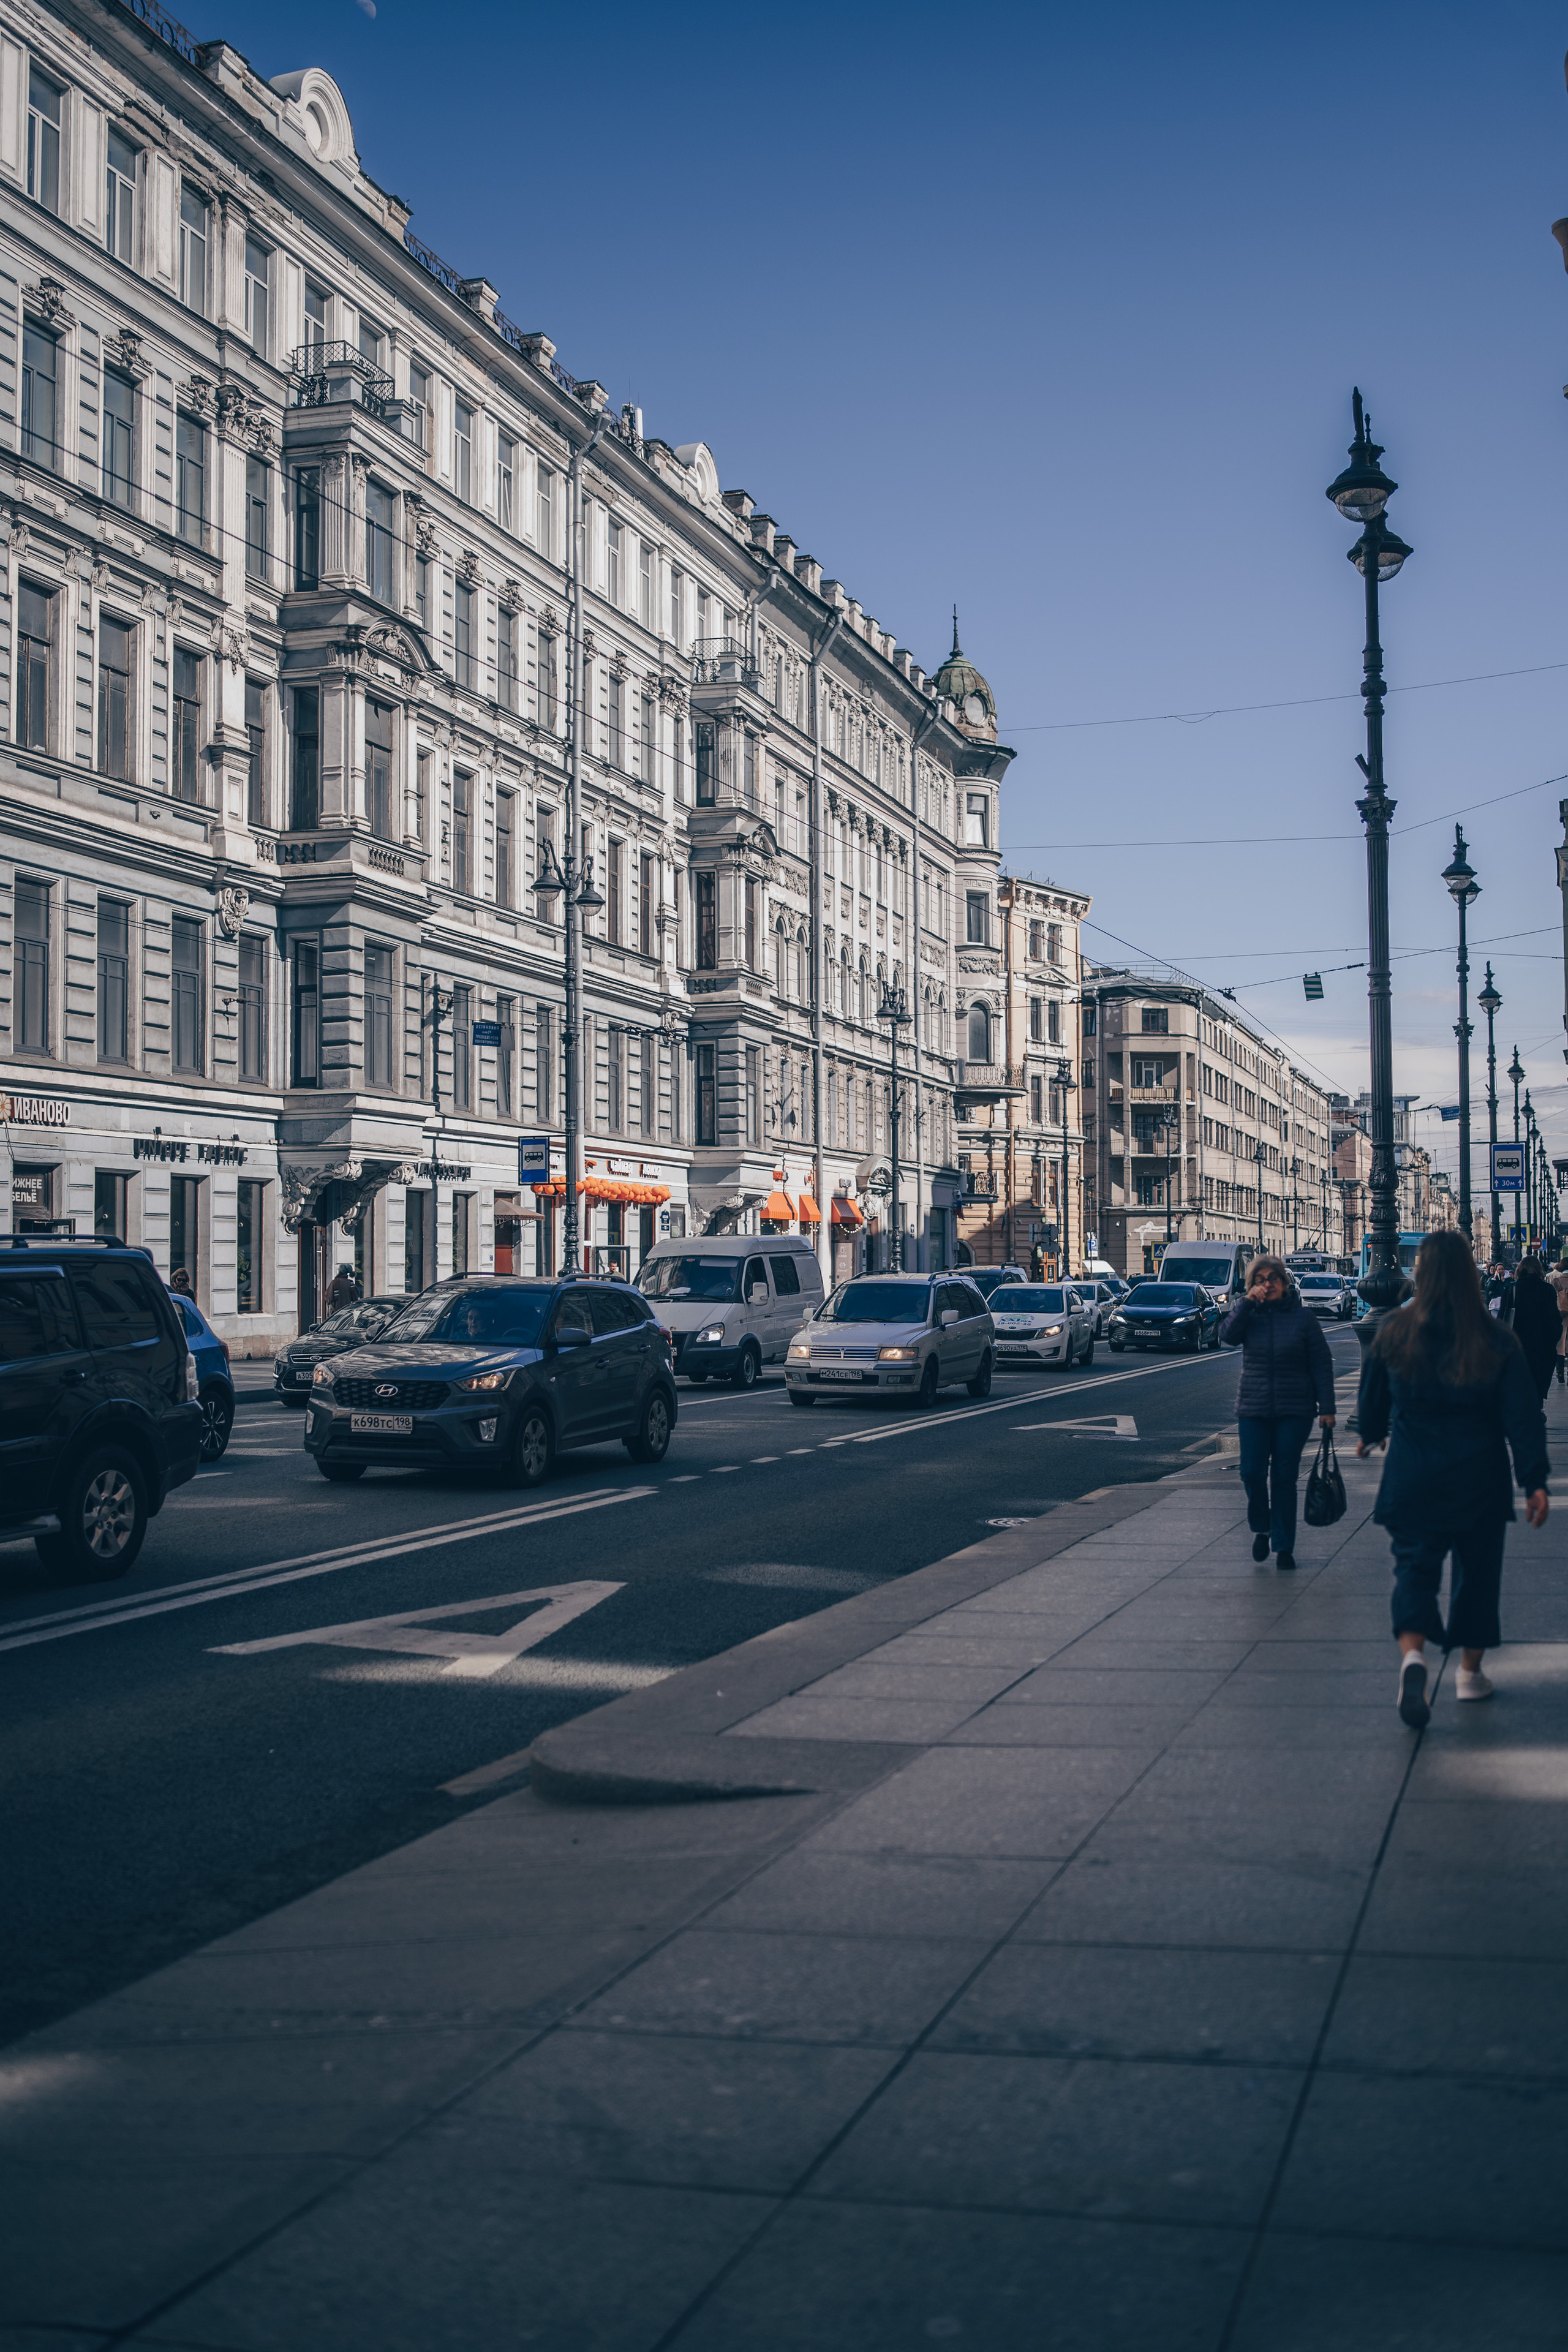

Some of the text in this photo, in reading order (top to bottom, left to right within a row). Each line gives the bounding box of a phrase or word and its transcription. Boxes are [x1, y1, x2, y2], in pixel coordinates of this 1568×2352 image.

[13, 1097, 71, 1125] ИВАНОВО
[134, 1139, 249, 1163] UNIQUE FABRIC
[12, 1177, 42, 1189] ИЖНЕЕ
[12, 1189, 37, 1202] БЕЛЬЁ
